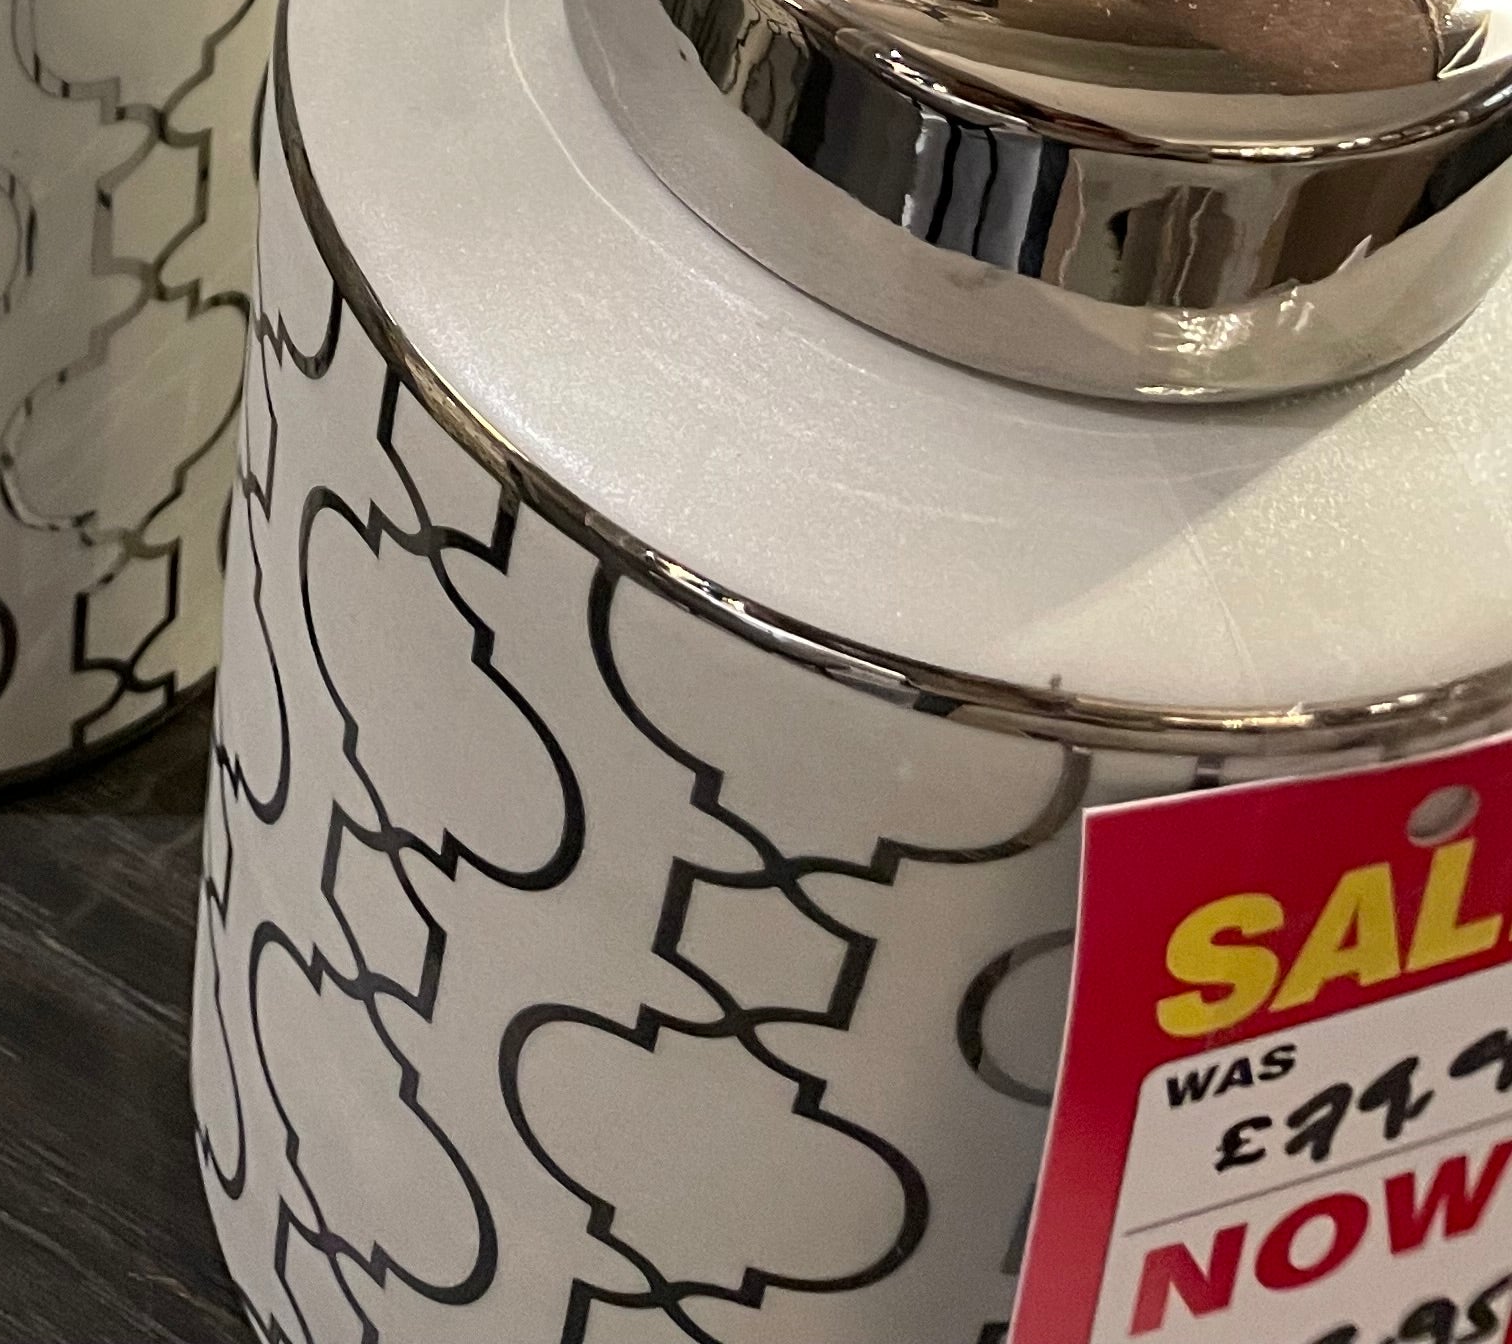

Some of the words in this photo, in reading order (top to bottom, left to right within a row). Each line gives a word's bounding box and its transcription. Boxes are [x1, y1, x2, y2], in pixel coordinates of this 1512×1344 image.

[1156, 837, 1512, 1038] SAL
[1165, 1043, 1297, 1109] WAS
[1128, 1140, 1512, 1338] NOW
